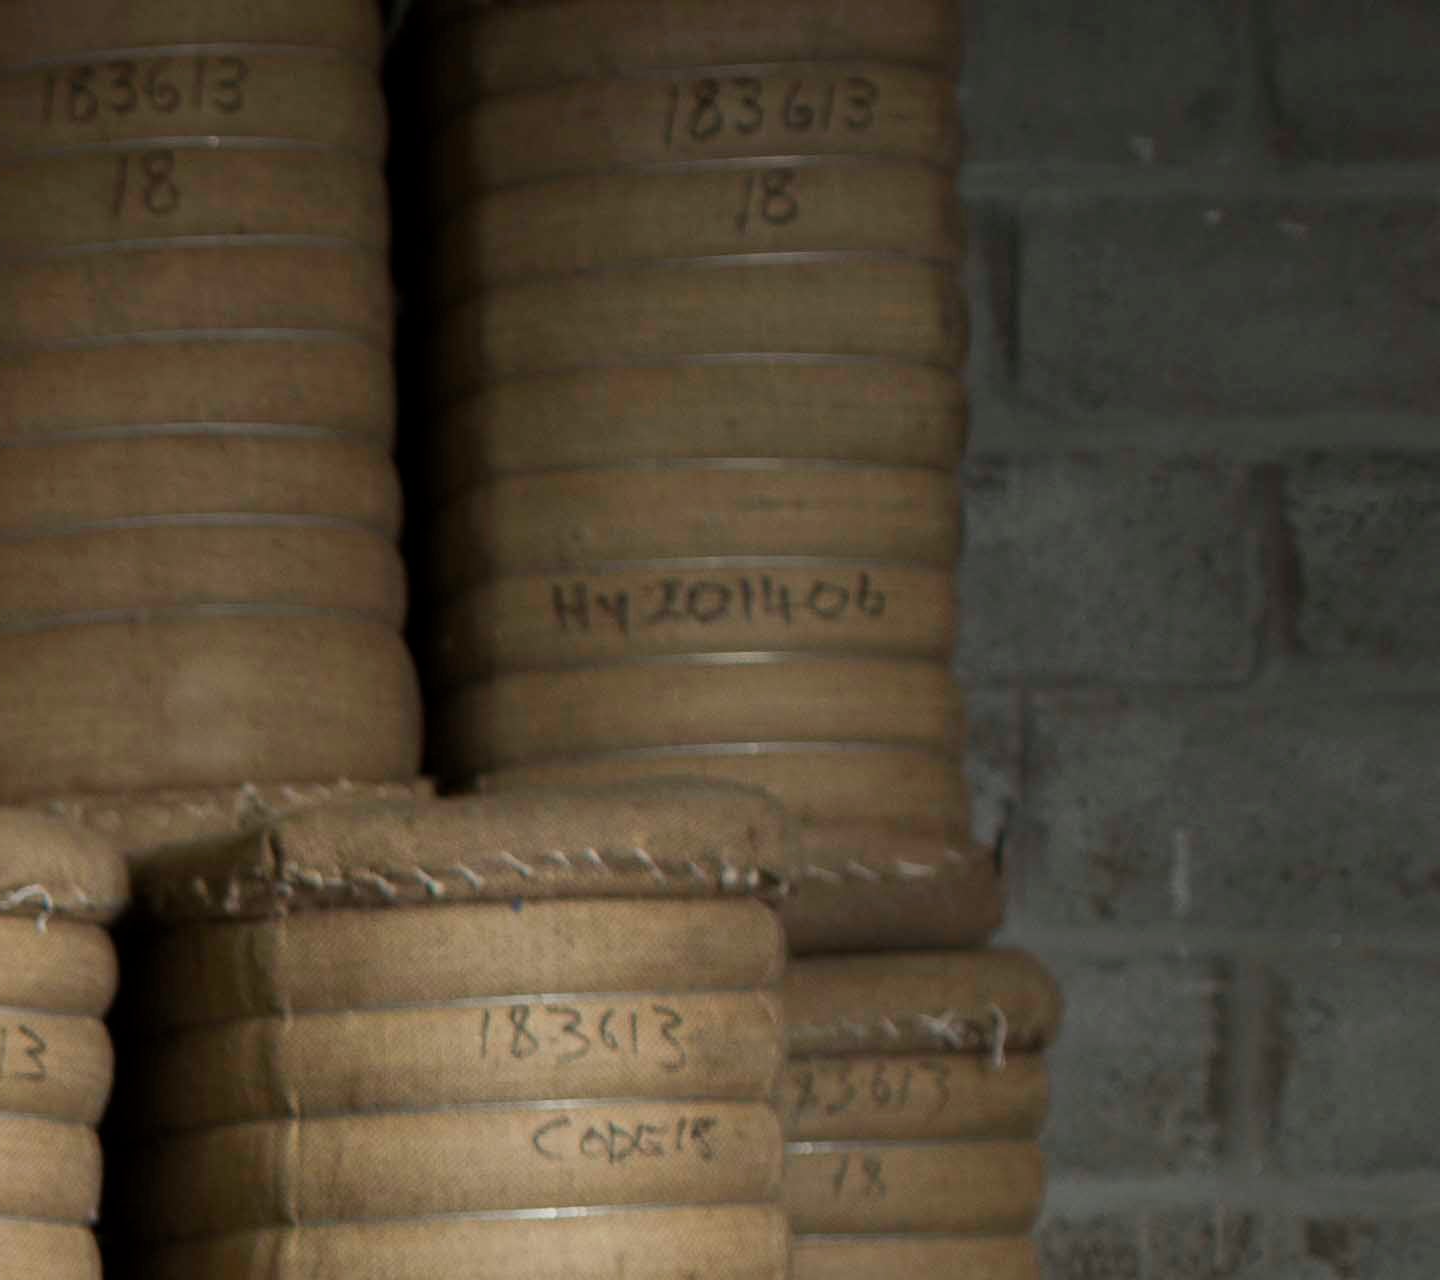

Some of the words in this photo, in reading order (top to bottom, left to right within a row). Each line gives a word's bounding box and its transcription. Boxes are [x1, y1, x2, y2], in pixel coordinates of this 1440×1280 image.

[42, 56, 250, 126] 183613
[664, 77, 880, 150] 183613
[112, 150, 181, 218] 18
[736, 168, 802, 235] 18
[479, 1003, 688, 1074] 183613
